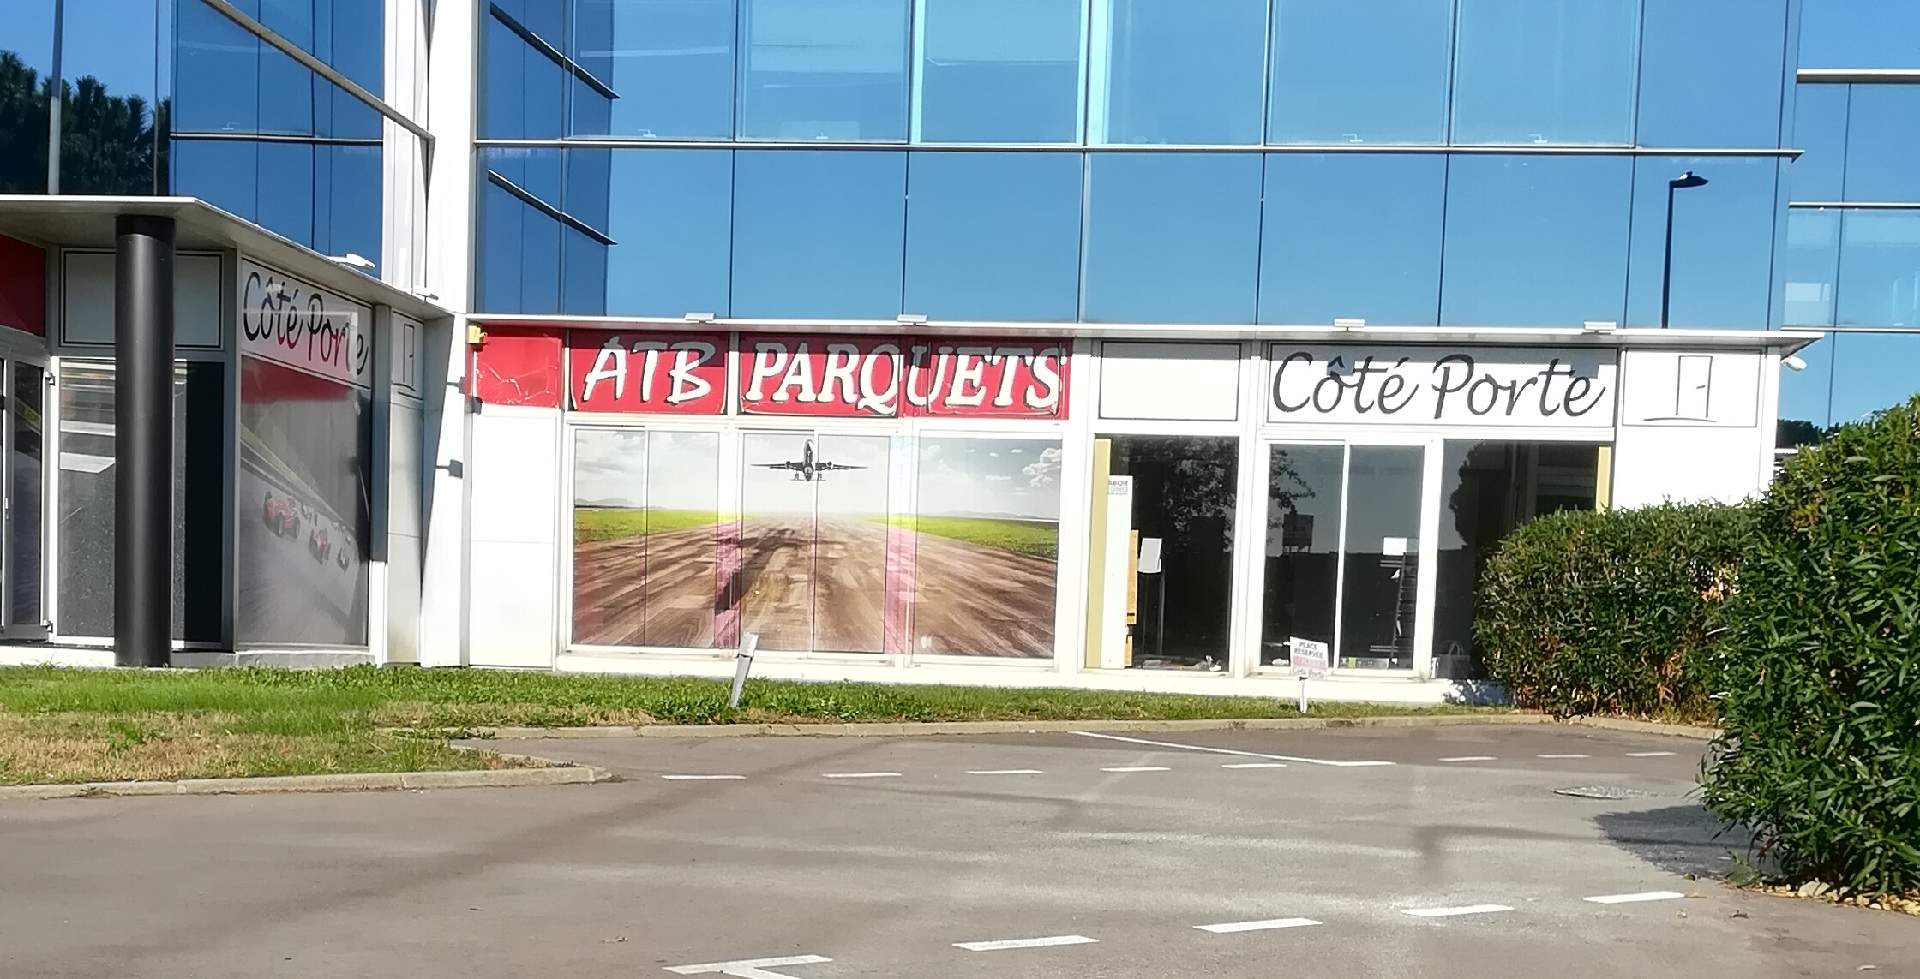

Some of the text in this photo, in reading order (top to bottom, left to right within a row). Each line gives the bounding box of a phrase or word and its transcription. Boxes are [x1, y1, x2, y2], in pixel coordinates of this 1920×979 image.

[243, 271, 303, 349] Côté
[582, 336, 1067, 415] ATB PARQUETS
[1273, 351, 1606, 419] Côté Porte
